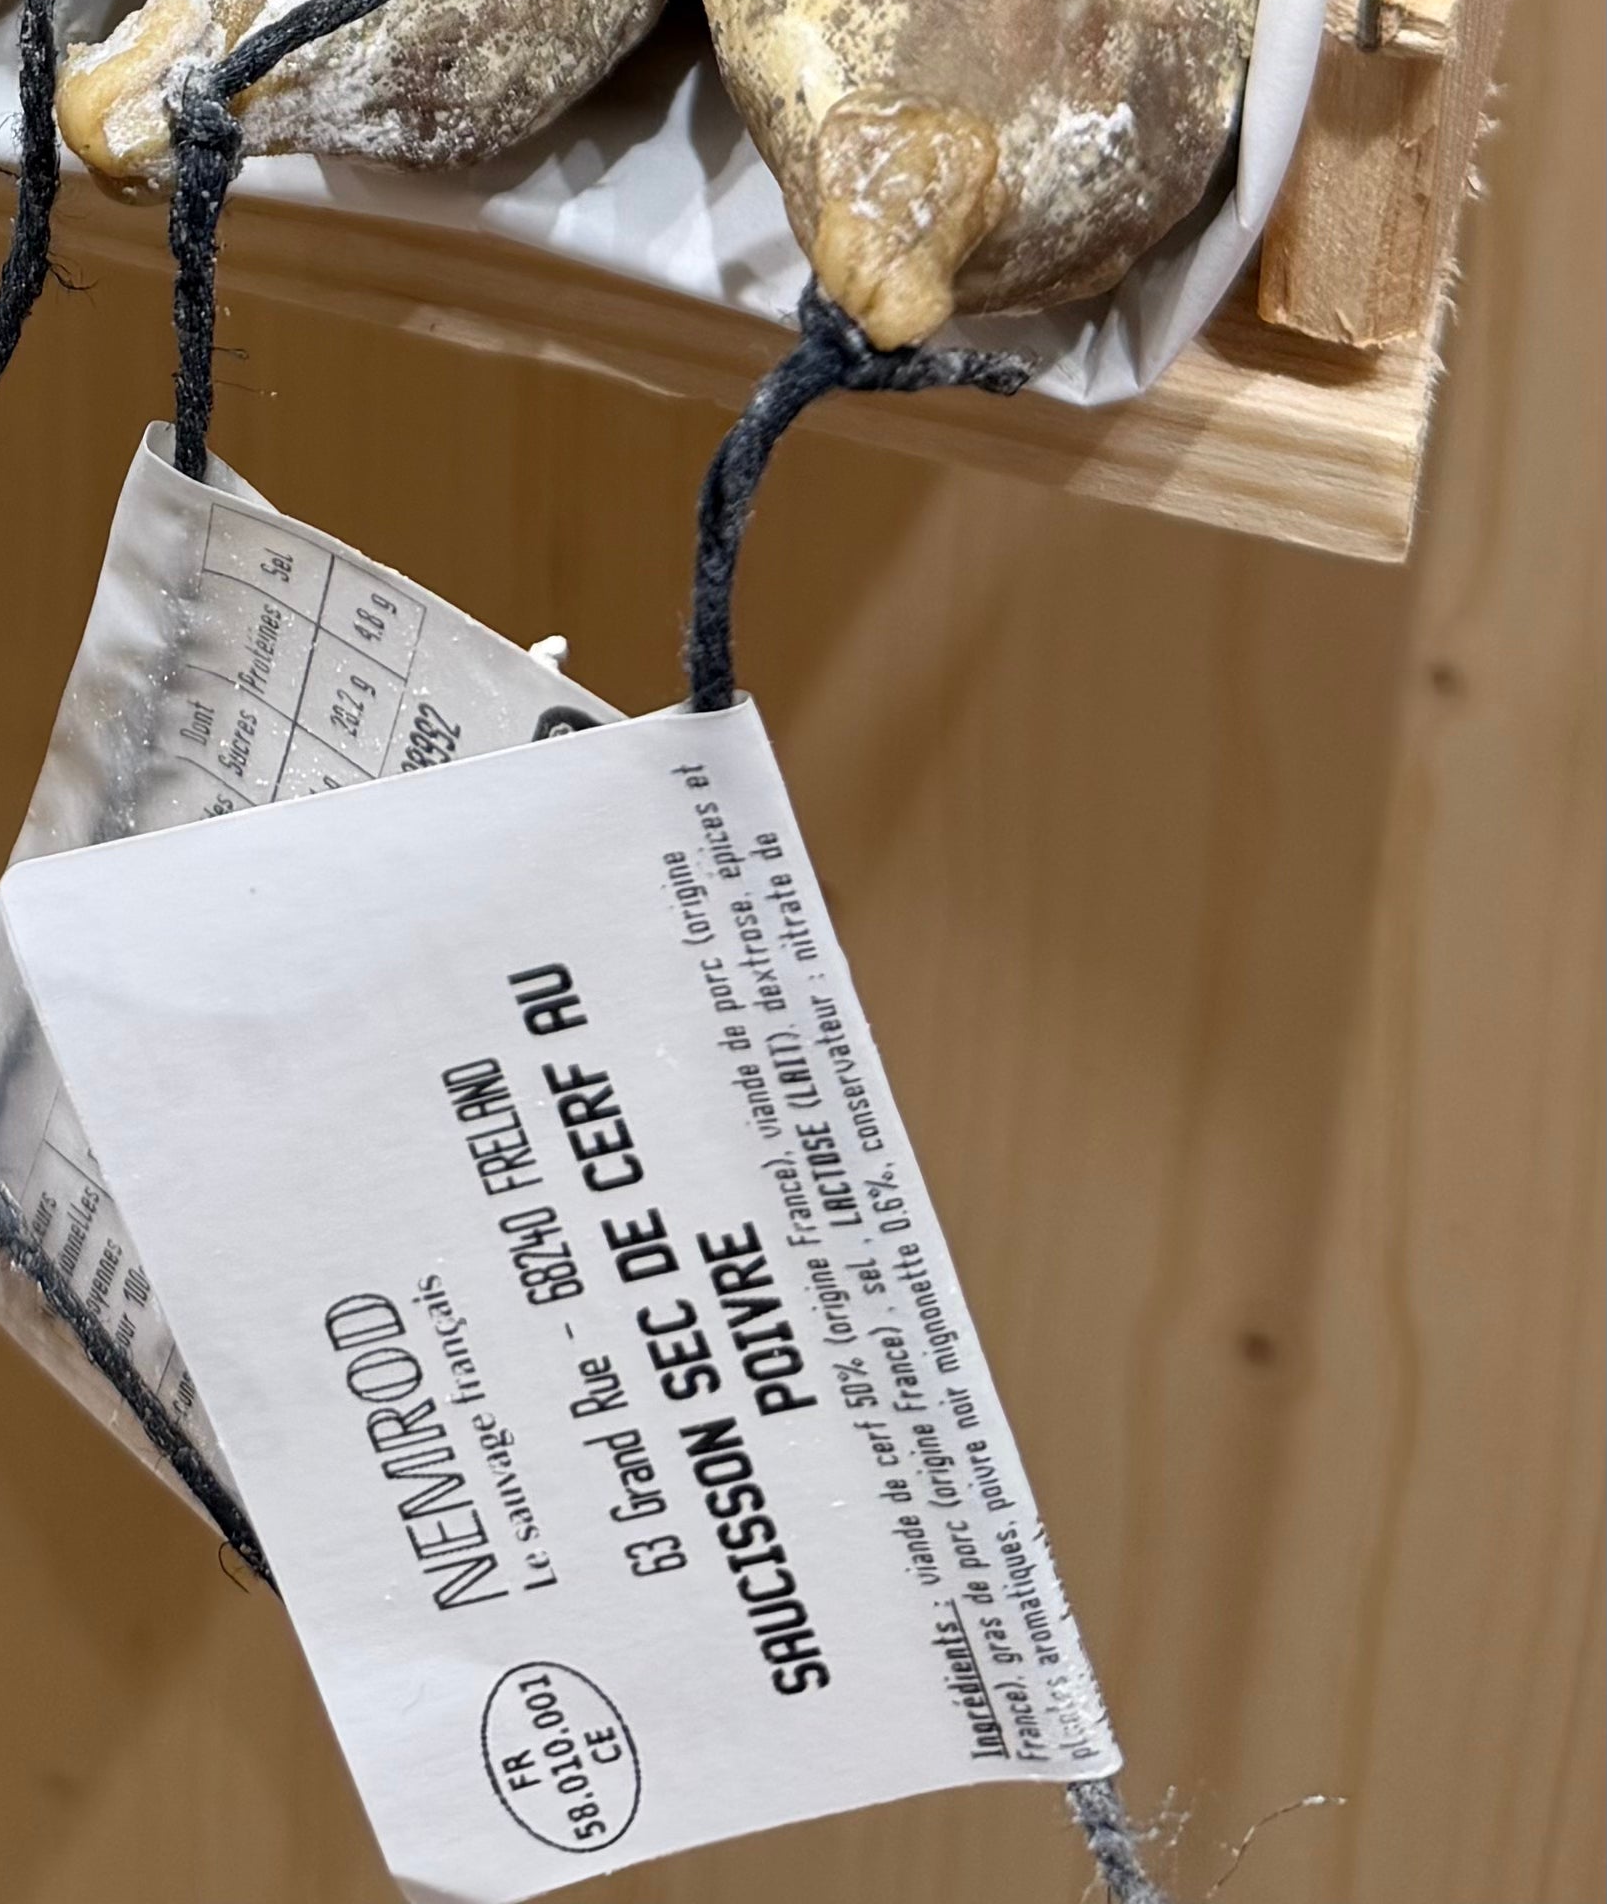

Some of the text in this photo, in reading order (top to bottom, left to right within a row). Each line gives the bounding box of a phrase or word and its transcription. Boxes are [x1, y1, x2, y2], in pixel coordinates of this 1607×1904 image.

[259, 547, 294, 584] Sel
[237, 603, 284, 695] Protéines
[353, 607, 386, 642] 4.8
[179, 689, 215, 748] Dont
[217, 709, 258, 779] Sucres
[671, 764, 711, 790] et
[694, 801, 747, 880] épices
[749, 832, 784, 862] de
[662, 851, 716, 946] (origine
[764, 873, 819, 962] nitrate
[700, 957, 747, 1013] porc
[729, 892, 787, 1013] dextrose,
[717, 1025, 752, 1052] de
[809, 995, 885, 1153] conservateur
[441, 1057, 544, 1196] FRELAND
[731, 1064, 782, 1140] viande
[760, 1150, 822, 1248] France),
[795, 1121, 863, 1227] LACTOSE
[498, 1206, 585, 1306] 68240
[844, 1257, 887, 1296] sel
[507, 963, 831, 1696] SAUCISSON SEC DE CERF AU
[696, 1221, 818, 1417] POIVRE
[804, 1258, 859, 1346] (origine
[892, 1242, 961, 1375] mignonette
[569, 1355, 629, 1419] Rue
[832, 1357, 880, 1410] 50%
[867, 1326, 928, 1413] France)
[411, 1274, 558, 1591] Le sauvage français
[853, 1421, 900, 1467] cerf
[939, 1387, 981, 1430] noir
[324, 1293, 510, 1612] NEMROD
[583, 1428, 668, 1523] Grand
[909, 1423, 963, 1509] (origine
[965, 1439, 1016, 1513] poivre
[879, 1478, 913, 1504] de
[623, 1534, 688, 1578] 63
[891, 1515, 942, 1586] viande
[945, 1520, 992, 1570] porc
[961, 1581, 995, 1605] de
[995, 1520, 1064, 1666] aromatiques,
[978, 1617, 1024, 1665] gras
[501, 1749, 542, 1792] FR
[507, 1672, 607, 1841] 58.010.001
[583, 1726, 623, 1765] CE
